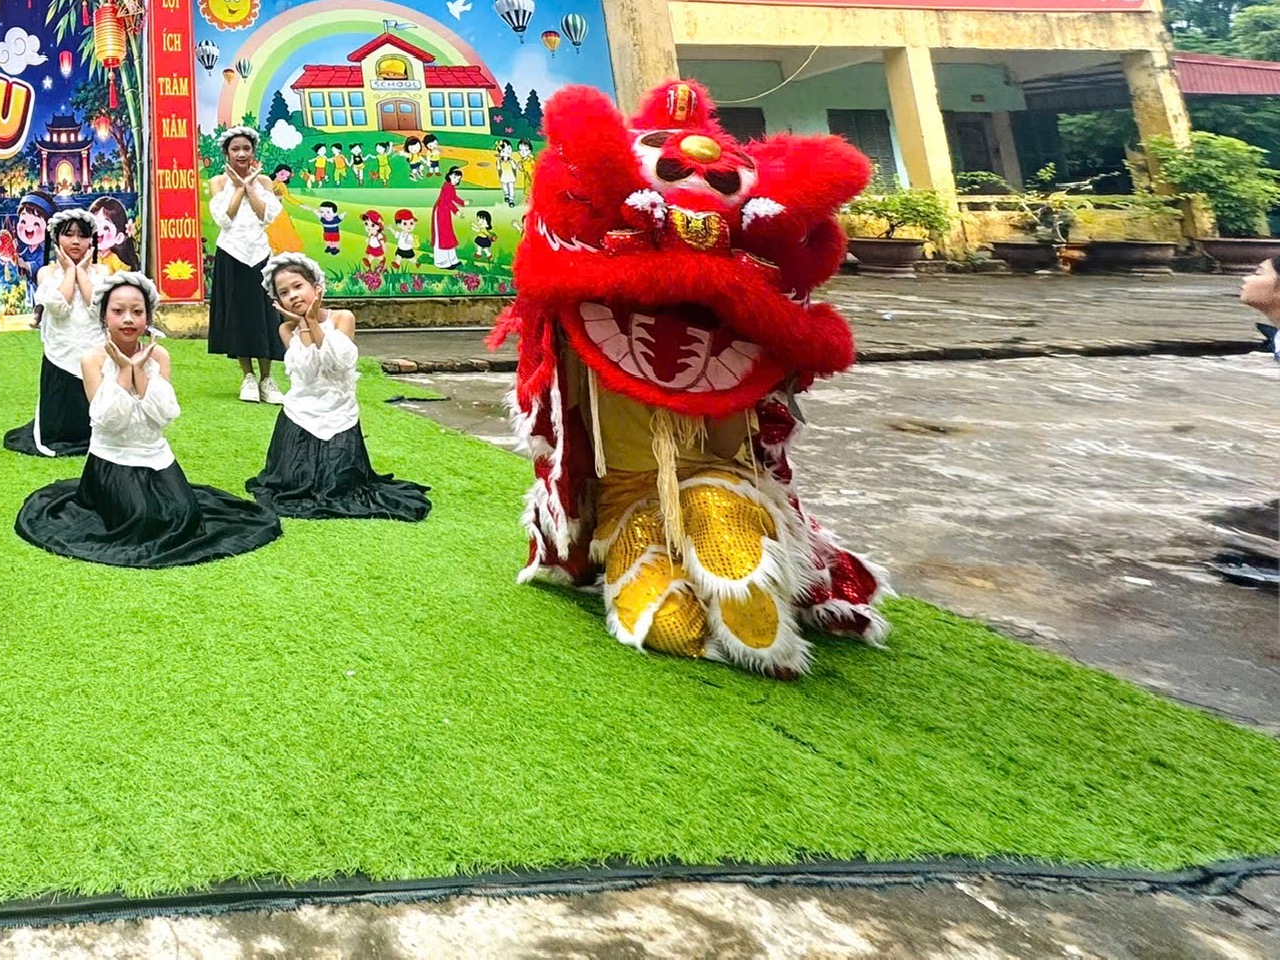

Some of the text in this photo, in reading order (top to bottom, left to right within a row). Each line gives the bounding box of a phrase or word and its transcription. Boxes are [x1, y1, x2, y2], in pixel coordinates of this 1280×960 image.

[162, 27, 182, 52] ÍCH
[158, 76, 189, 96] TRĂM
[374, 81, 419, 89] SCHOOL
[162, 114, 187, 138] NĂM
[157, 158, 195, 189] TRỒNG
[159, 211, 196, 239] NGƯỜI
